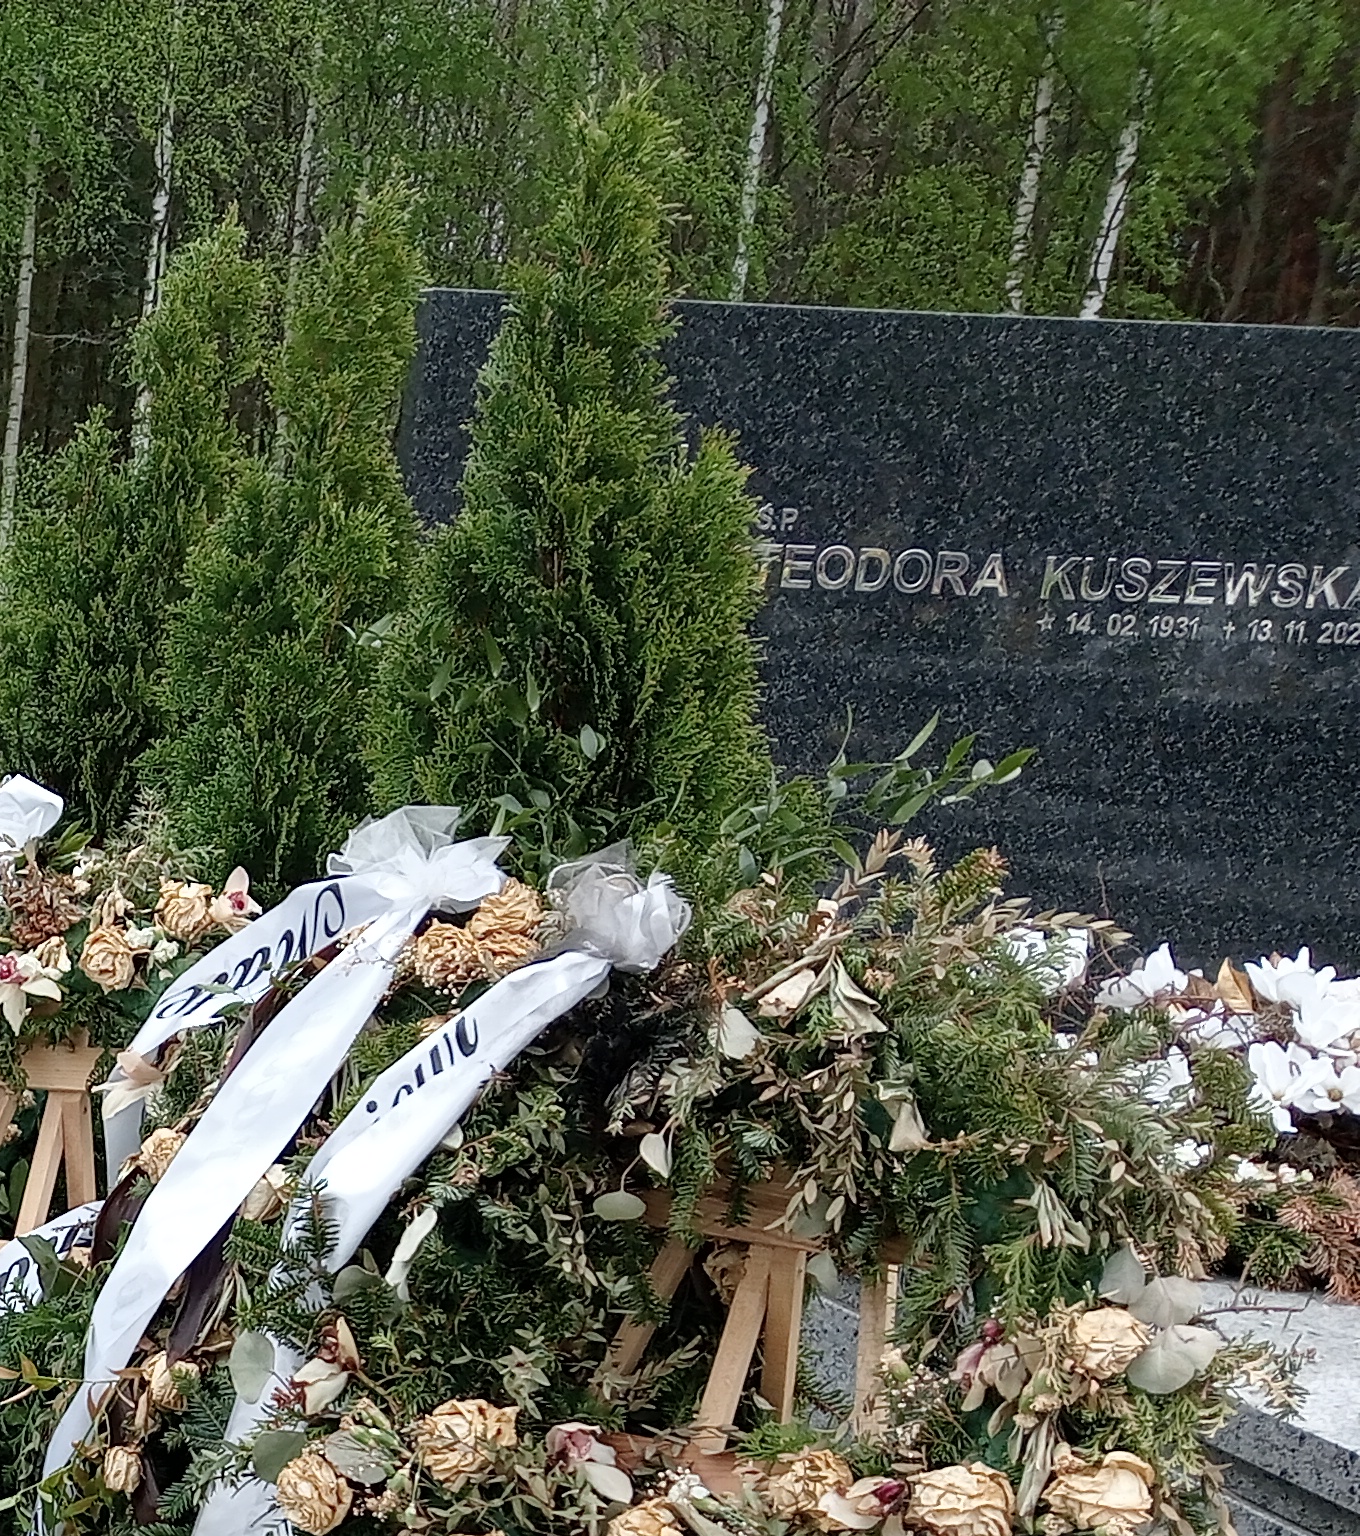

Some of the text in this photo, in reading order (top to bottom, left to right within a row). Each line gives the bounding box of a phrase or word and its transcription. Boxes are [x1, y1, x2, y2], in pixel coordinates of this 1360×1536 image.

[1066, 612, 1360, 645] 14. 02. 1931 13. 11. 202
